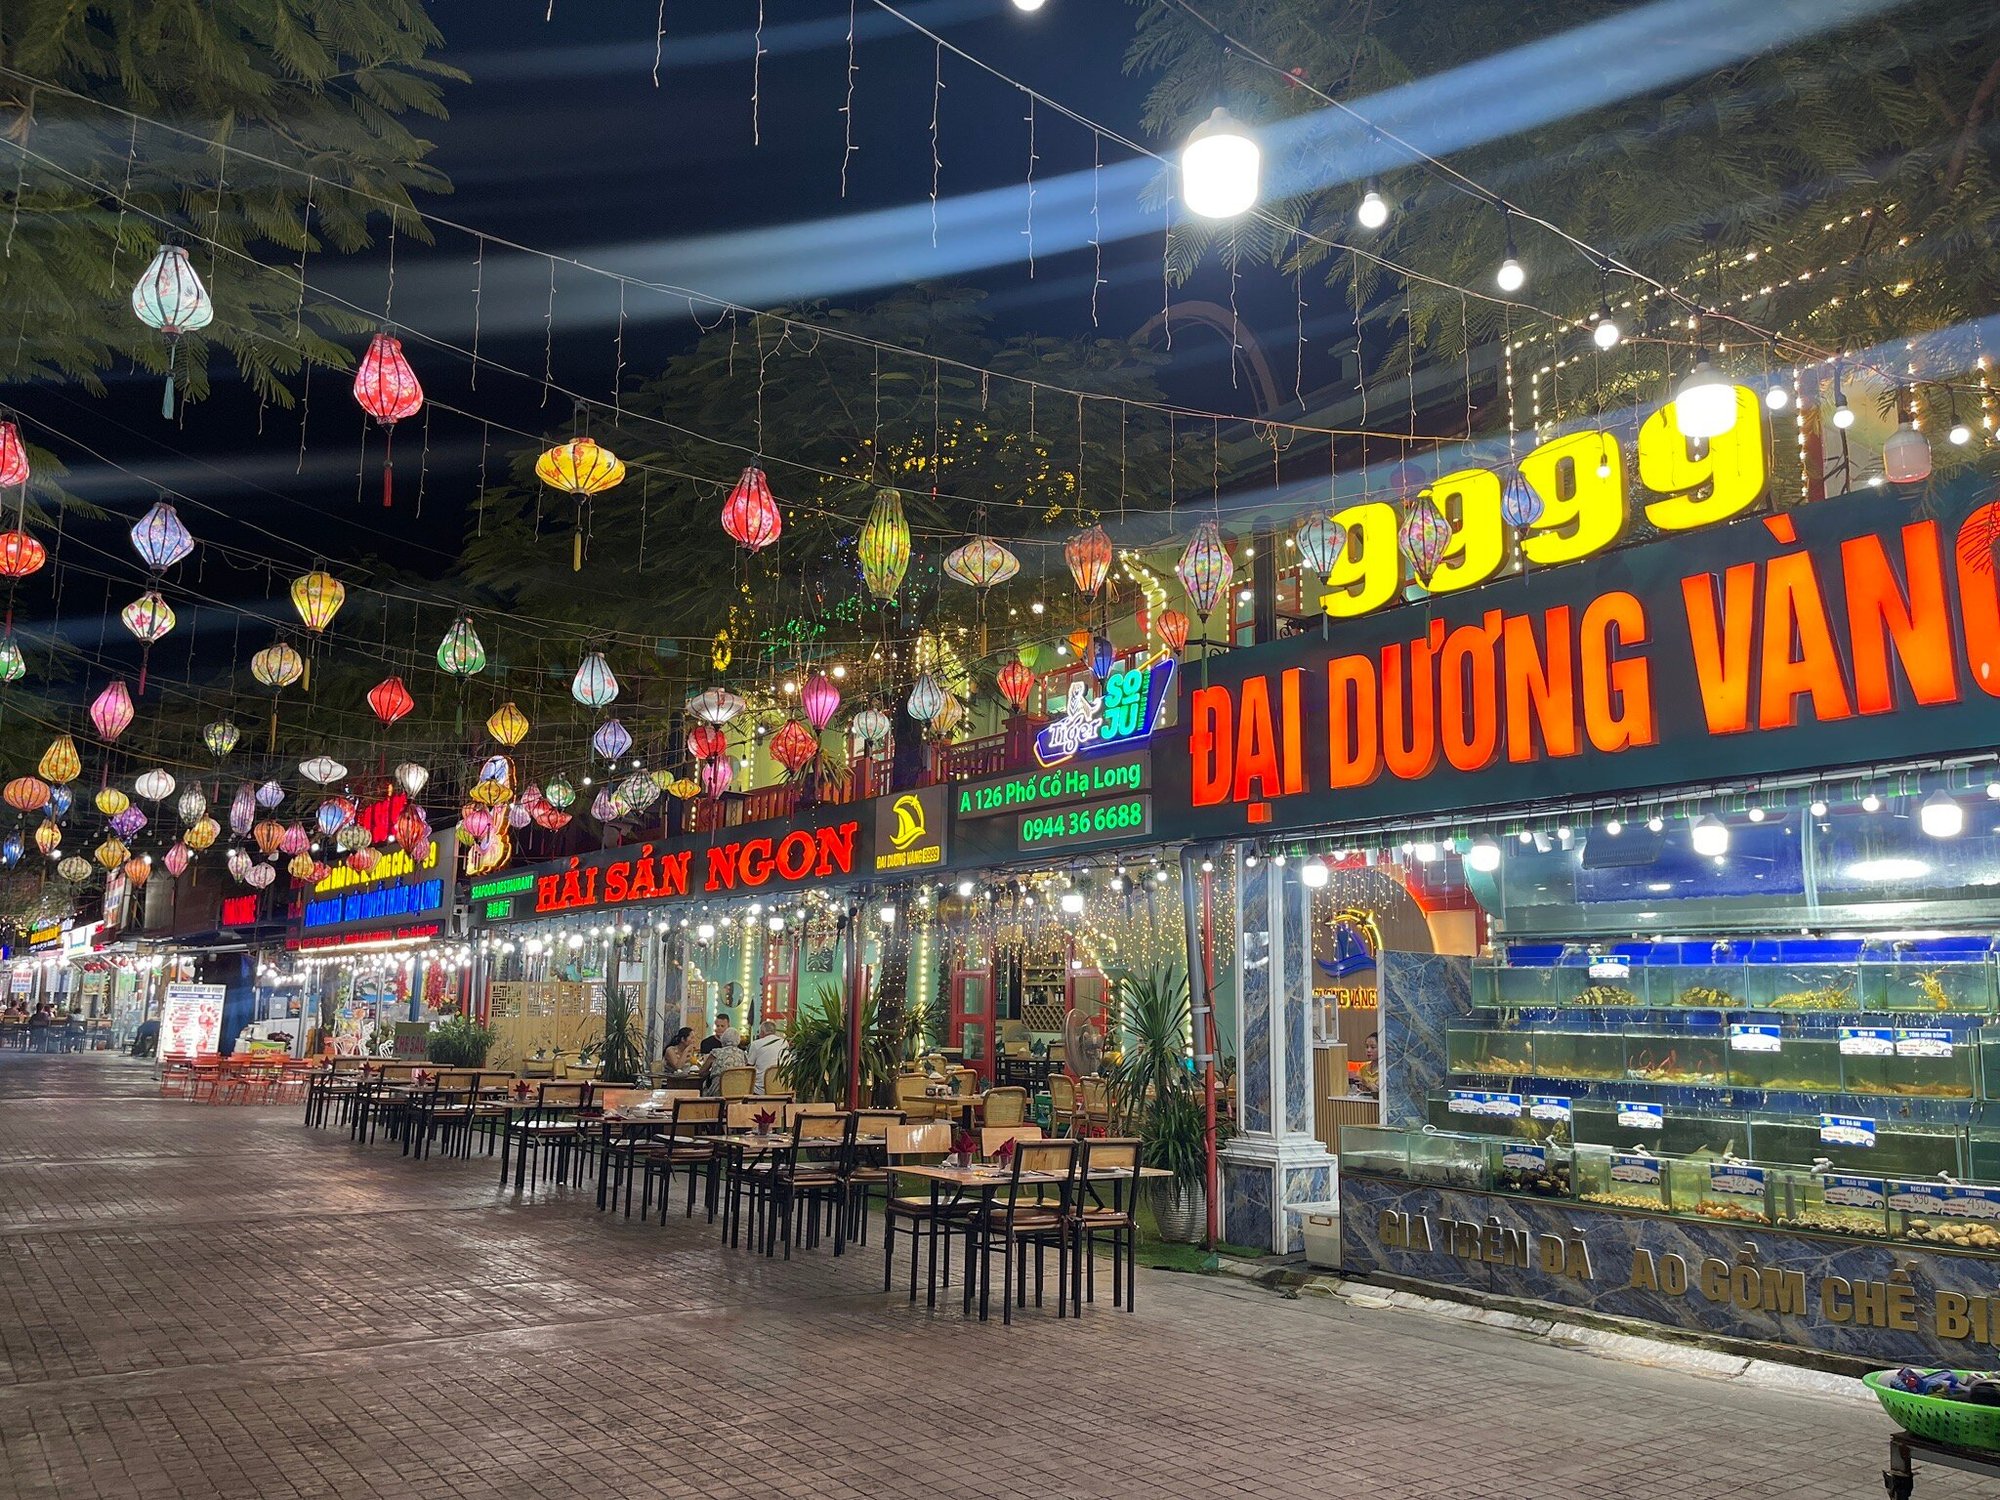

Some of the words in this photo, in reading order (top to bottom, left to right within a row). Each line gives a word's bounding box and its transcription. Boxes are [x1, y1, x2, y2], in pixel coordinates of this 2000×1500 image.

[1319, 383, 1765, 618] 9999
[1191, 667, 1307, 825] ĐẠI
[1329, 592, 1656, 789] DƯƠNG
[1049, 713, 1103, 754] Tiger
[960, 792, 971, 813] A
[976, 786, 1002, 810] 126
[1006, 774, 1037, 804] Phố
[1040, 769, 1063, 799] Cổ
[1066, 770, 1090, 798] Hạ
[1094, 763, 1142, 790] Long
[1023, 814, 1065, 842] 0944
[1069, 809, 1092, 835] 36
[1095, 803, 1142, 831] 6688
[705, 821, 858, 892] NGON
[924, 847, 939, 862] 9999
[471, 882, 497, 899] SEAFOOD
[497, 874, 535, 895] RESTAURANT
[1350, 984, 1377, 1008] VÀNG
[1379, 1206, 1433, 1252] GIÁ
[1439, 1215, 1530, 1269] TRÊN
[1630, 1246, 1690, 1296] AO
[1701, 1242, 1807, 1316] GỒM
[1821, 1260, 1919, 1332] CHẾ
[1935, 1290, 2000, 1346] BI
